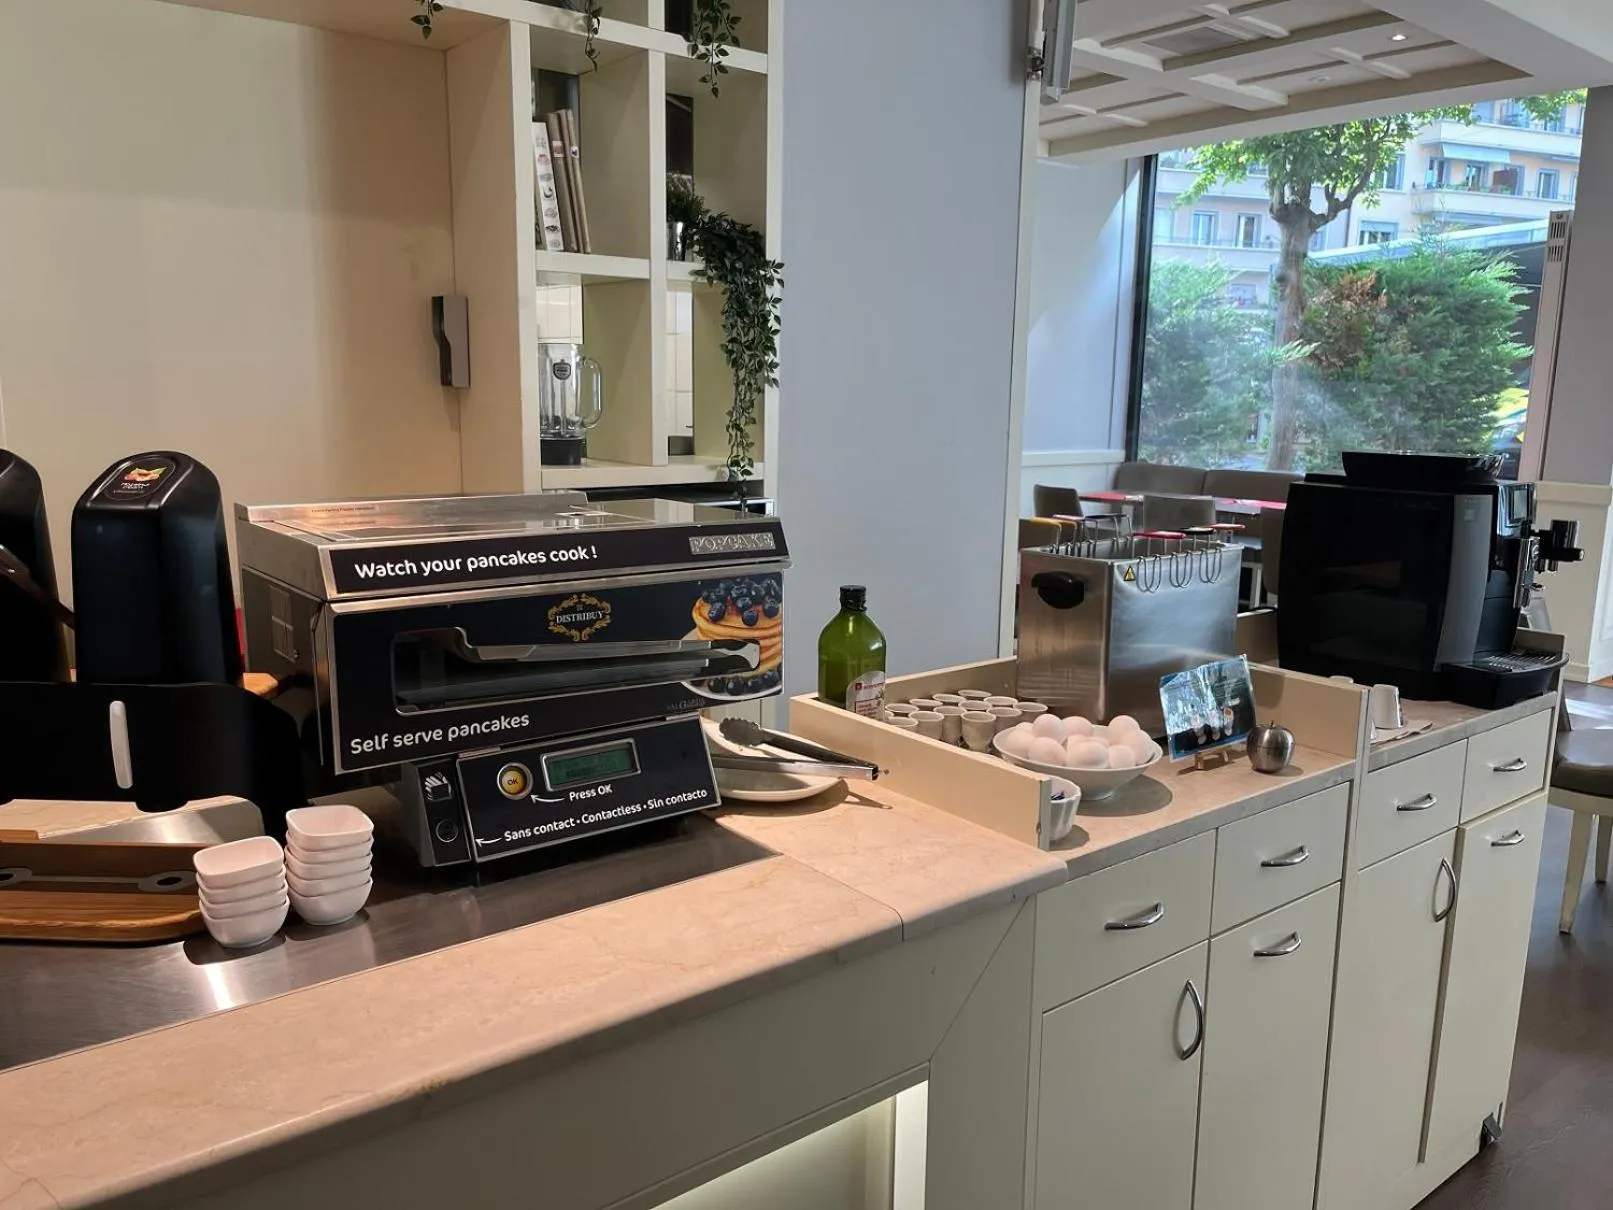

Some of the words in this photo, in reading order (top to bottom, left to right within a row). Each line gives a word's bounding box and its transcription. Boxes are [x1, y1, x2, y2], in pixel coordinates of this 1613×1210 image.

[355, 560, 418, 579] Watch
[420, 558, 463, 576] your
[467, 550, 547, 573] pancakes
[556, 611, 604, 624] DISTRIBUY
[350, 733, 389, 754] Self
[393, 729, 443, 748] serve
[448, 714, 530, 741] pancakes
[507, 777, 519, 786] OK
[569, 788, 597, 801] Press
[598, 784, 613, 795] OK
[504, 828, 532, 842] Sans
[533, 818, 576, 836] contact
[581, 804, 642, 824] Contactless
[647, 798, 664, 810] Sin
[665, 789, 708, 806] contacto
